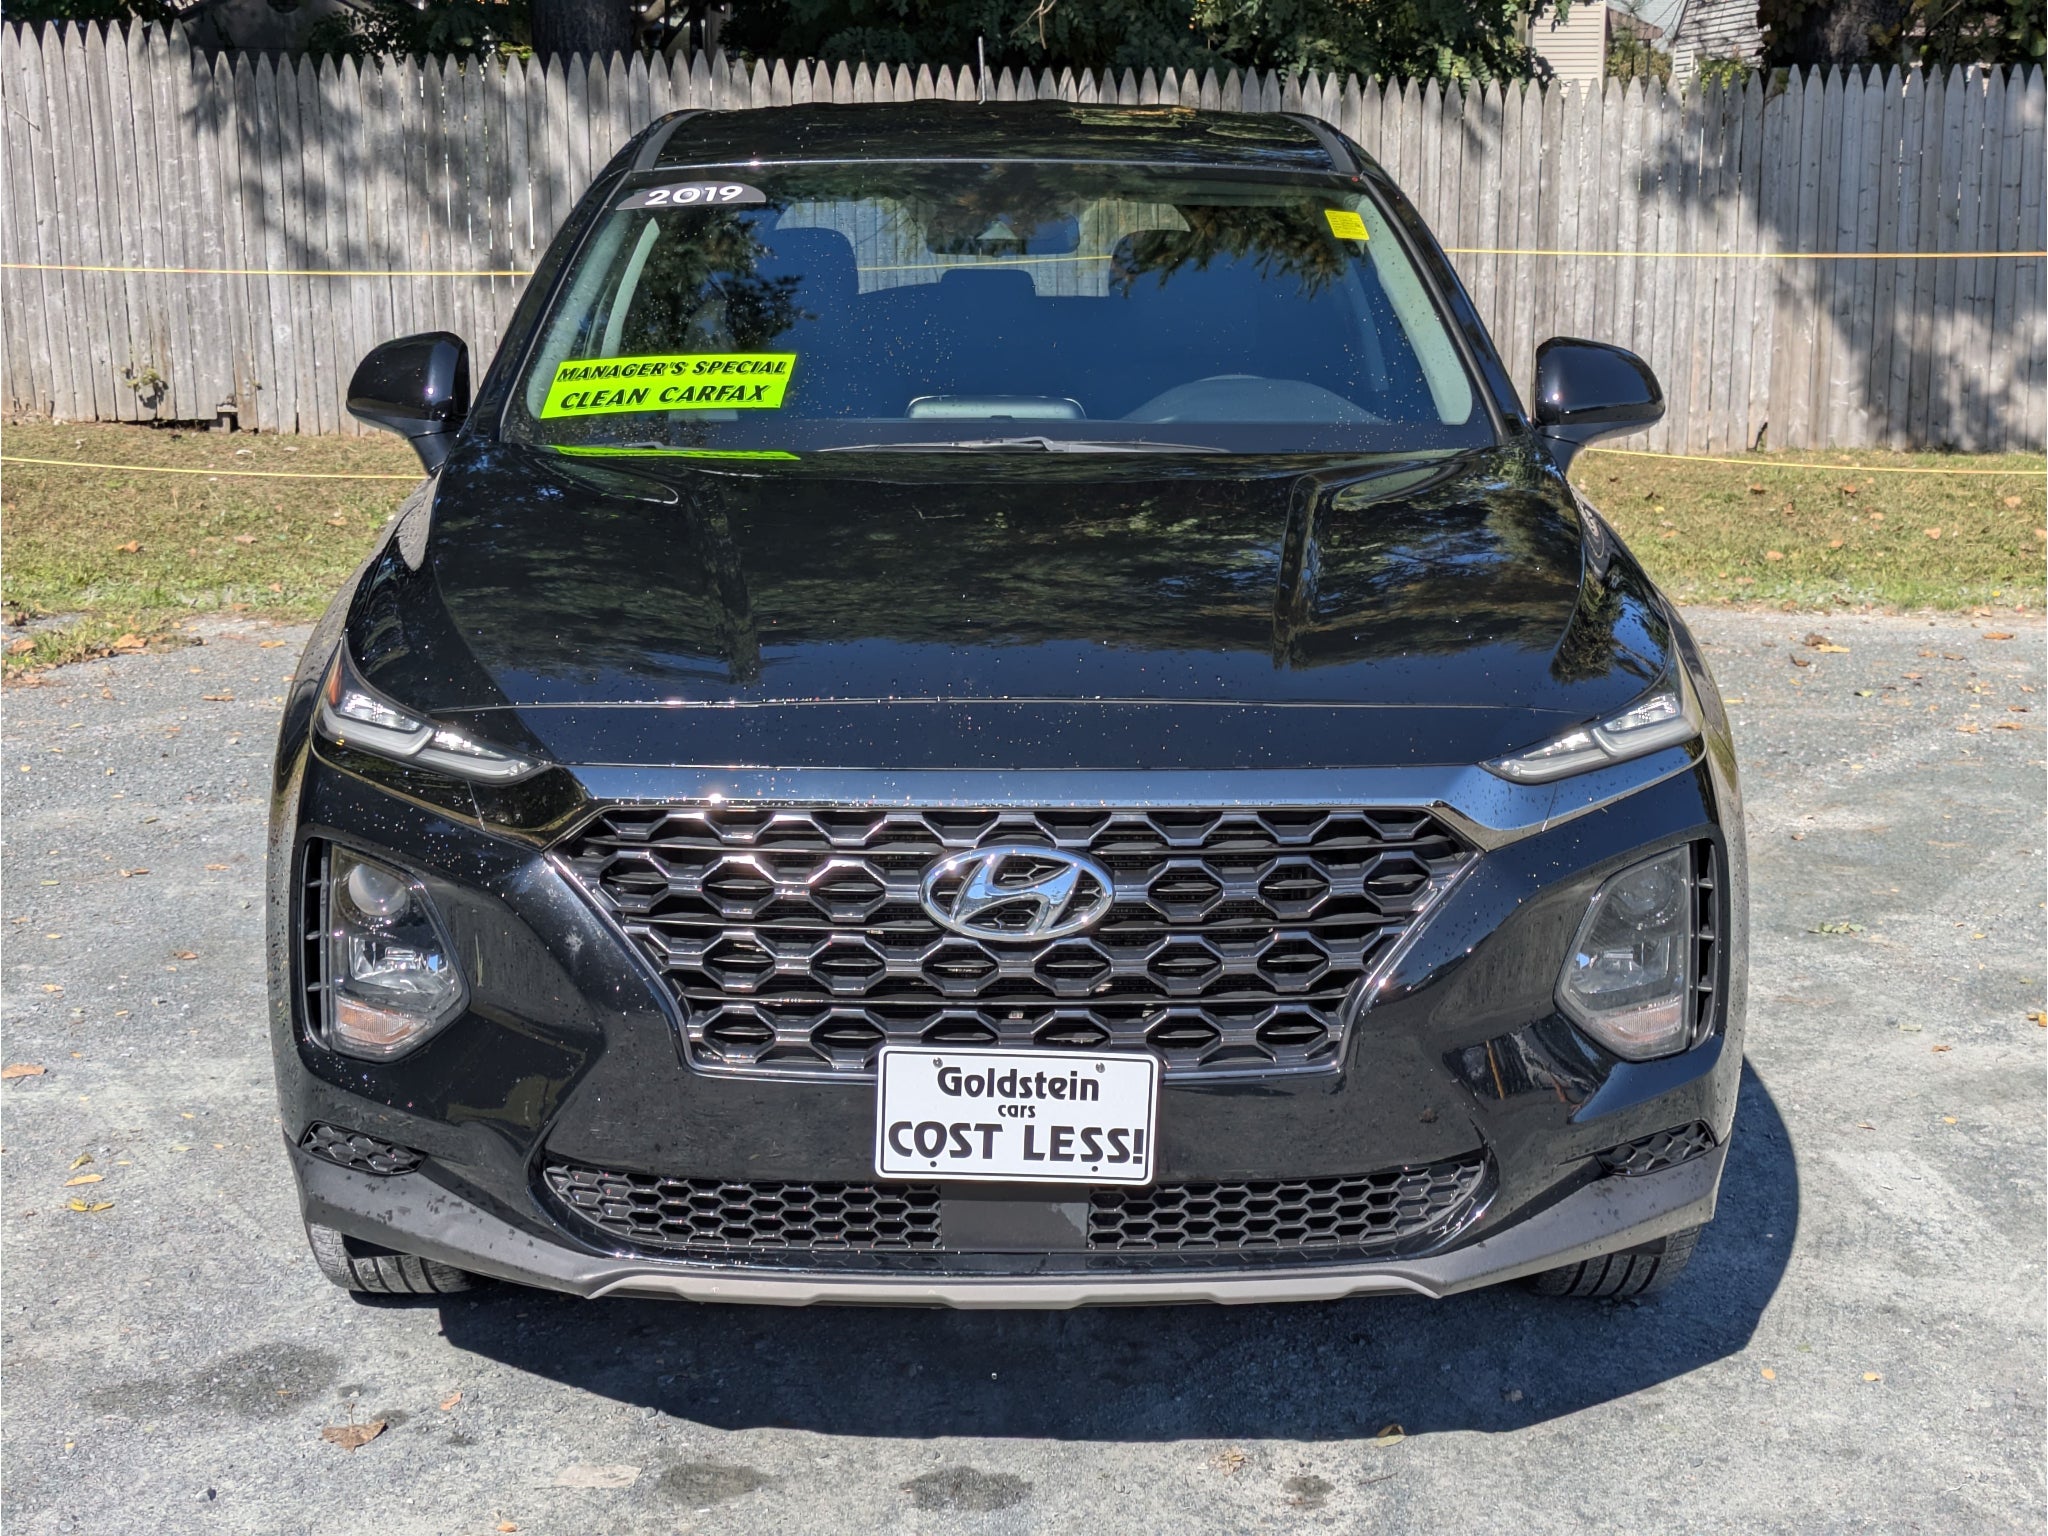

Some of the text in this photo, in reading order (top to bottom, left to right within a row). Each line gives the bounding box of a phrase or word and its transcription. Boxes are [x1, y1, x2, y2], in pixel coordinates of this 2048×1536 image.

[645, 186, 743, 206] 2019
[557, 360, 786, 383] MANAGER'S SPECIAL
[560, 384, 771, 410] CLEAN CARFAX
[937, 1066, 1100, 1101] Goldstein
[998, 1103, 1036, 1118] cars
[888, 1121, 1145, 1165] COST LESS!
